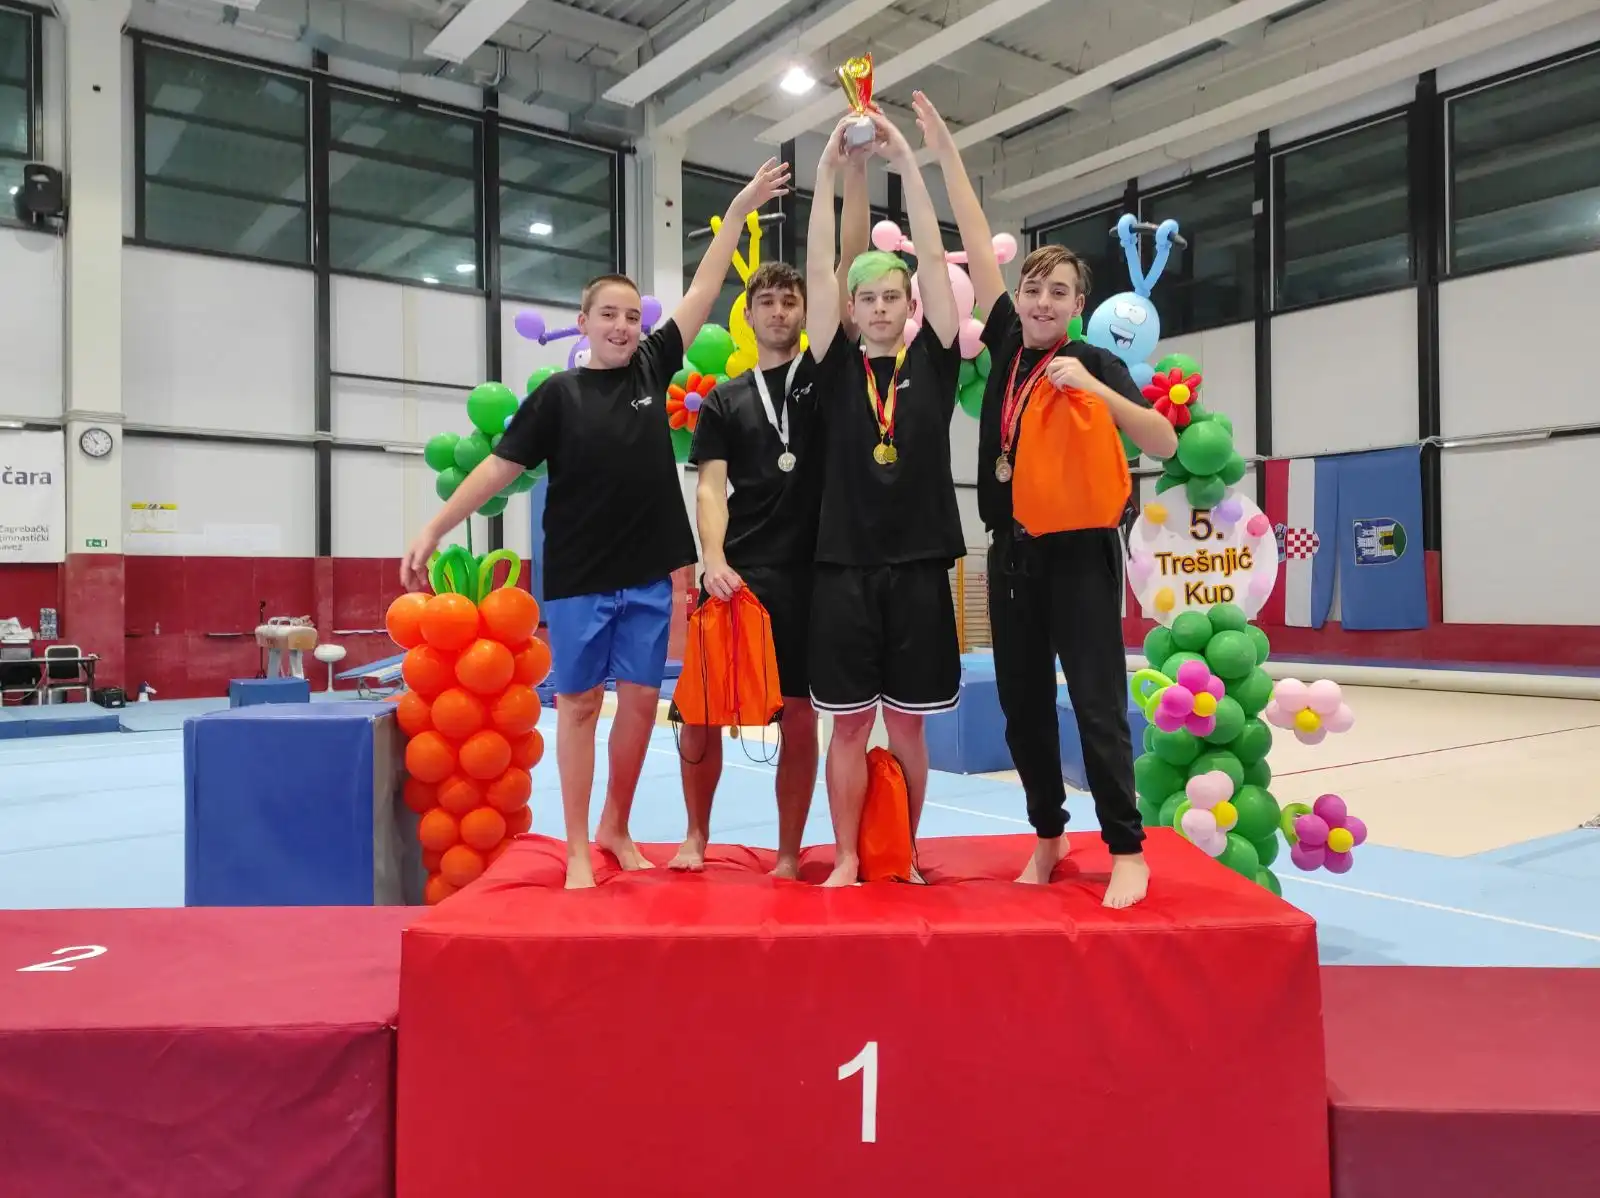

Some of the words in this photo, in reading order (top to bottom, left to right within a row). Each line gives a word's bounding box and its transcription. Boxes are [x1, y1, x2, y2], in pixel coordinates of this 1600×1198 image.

[2, 465, 52, 485] čara
[1190, 508, 1224, 540] 5.
[1155, 546, 1253, 577] Trešnjić
[1185, 581, 1234, 605] Kup
[15, 945, 108, 972] 2
[838, 1041, 878, 1143] 1
